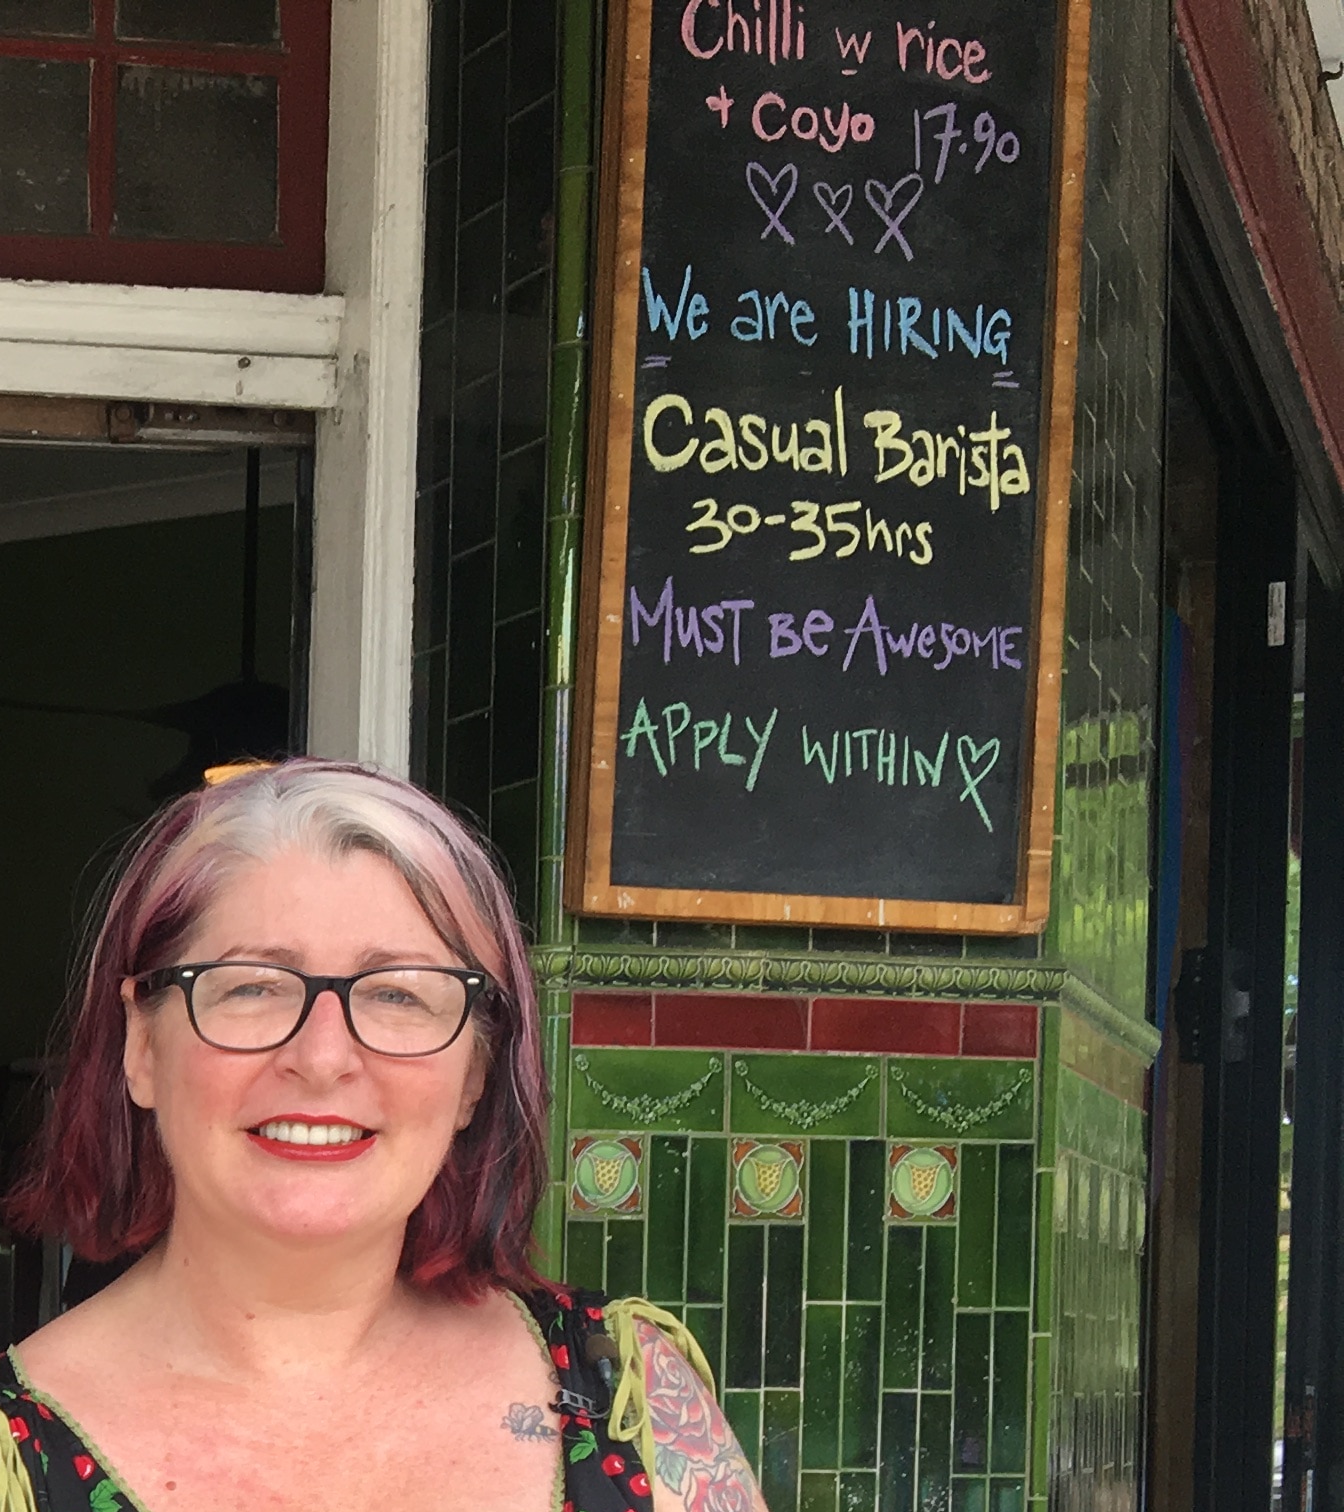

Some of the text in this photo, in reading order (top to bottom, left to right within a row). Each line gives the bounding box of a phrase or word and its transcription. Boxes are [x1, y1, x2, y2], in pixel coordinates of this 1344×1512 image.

[681, 0, 805, 65] Chilli
[896, 20, 991, 84] rice
[752, 92, 875, 153] Coyo
[914, 103, 1020, 184] 17.90
[642, 264, 1013, 364] We are HIRING
[643, 385, 1030, 514] Casual Barista
[685, 499, 934, 565] 30-35hrs
[621, 697, 949, 792] APPLY WITHIN
